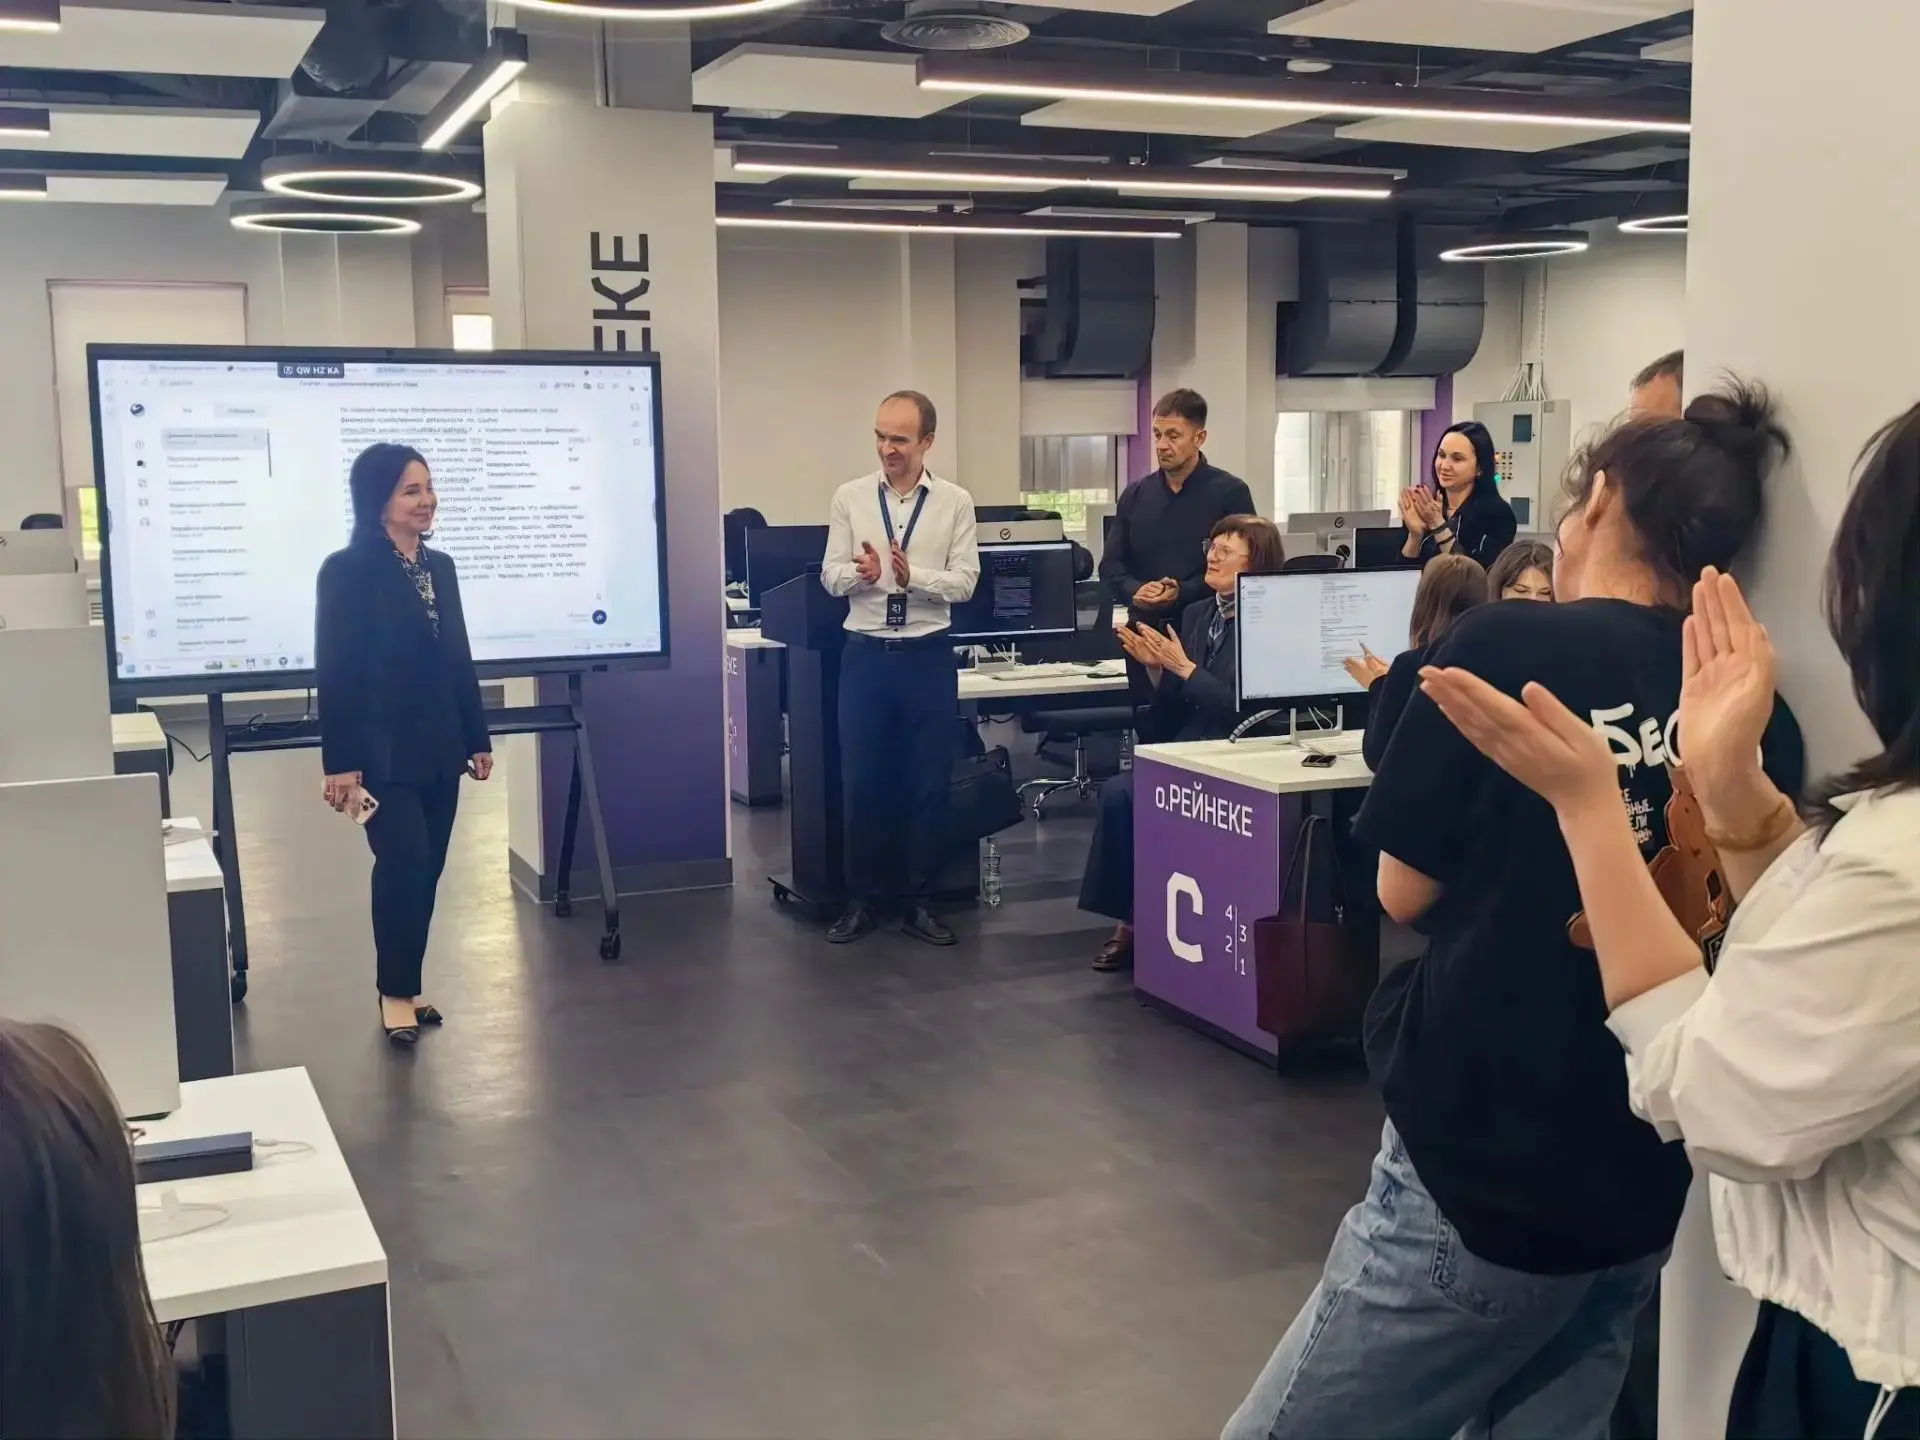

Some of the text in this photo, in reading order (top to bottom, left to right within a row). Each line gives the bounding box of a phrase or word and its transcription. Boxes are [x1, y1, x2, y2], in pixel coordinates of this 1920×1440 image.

[296, 366, 311, 375] QW
[327, 366, 340, 375] KA
[1155, 781, 1253, 838] о.РЕЙНЕКЕ
[1225, 904, 1233, 921] 4
[1239, 924, 1247, 942] 3
[1225, 935, 1233, 953] 2
[1239, 958, 1246, 975] 1
